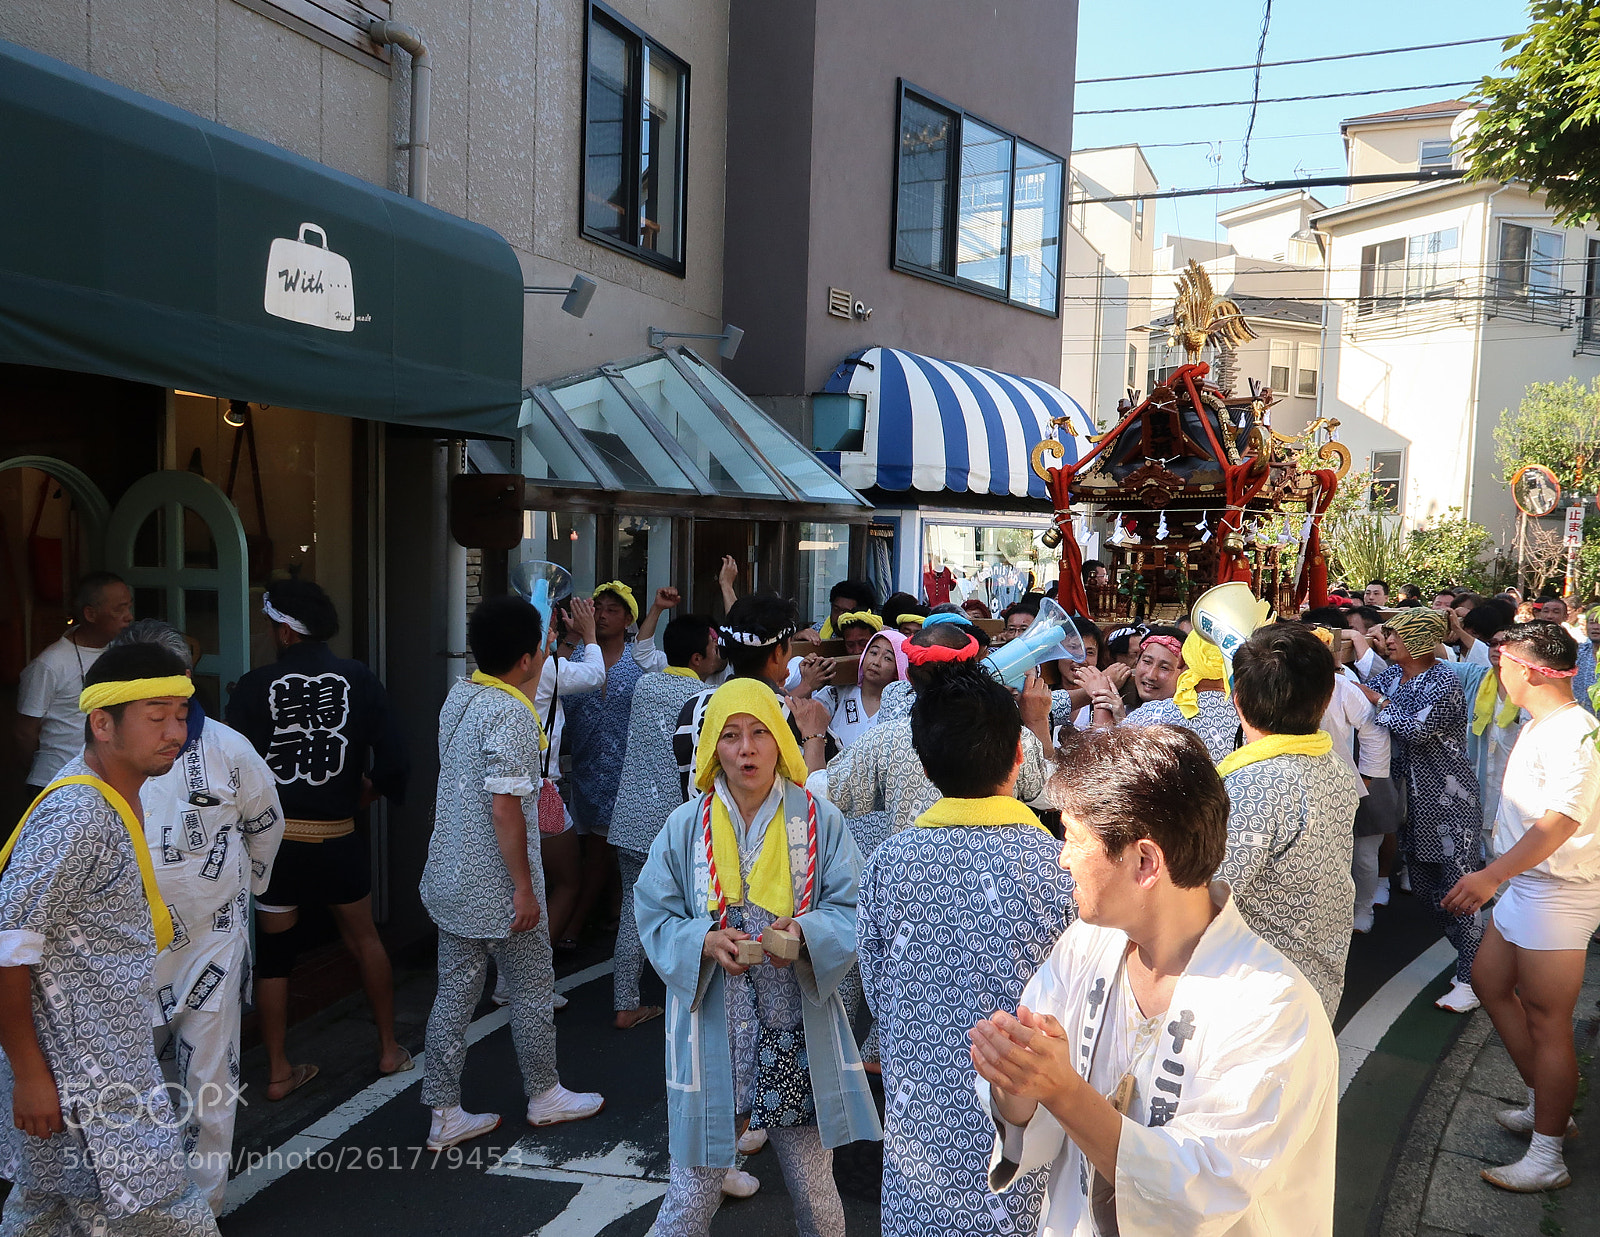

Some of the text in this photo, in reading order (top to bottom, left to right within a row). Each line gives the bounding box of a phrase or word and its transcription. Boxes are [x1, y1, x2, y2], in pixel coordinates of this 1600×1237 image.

[334, 311, 352, 321] Hand
[1567, 510, 1581, 544] 止まれ
